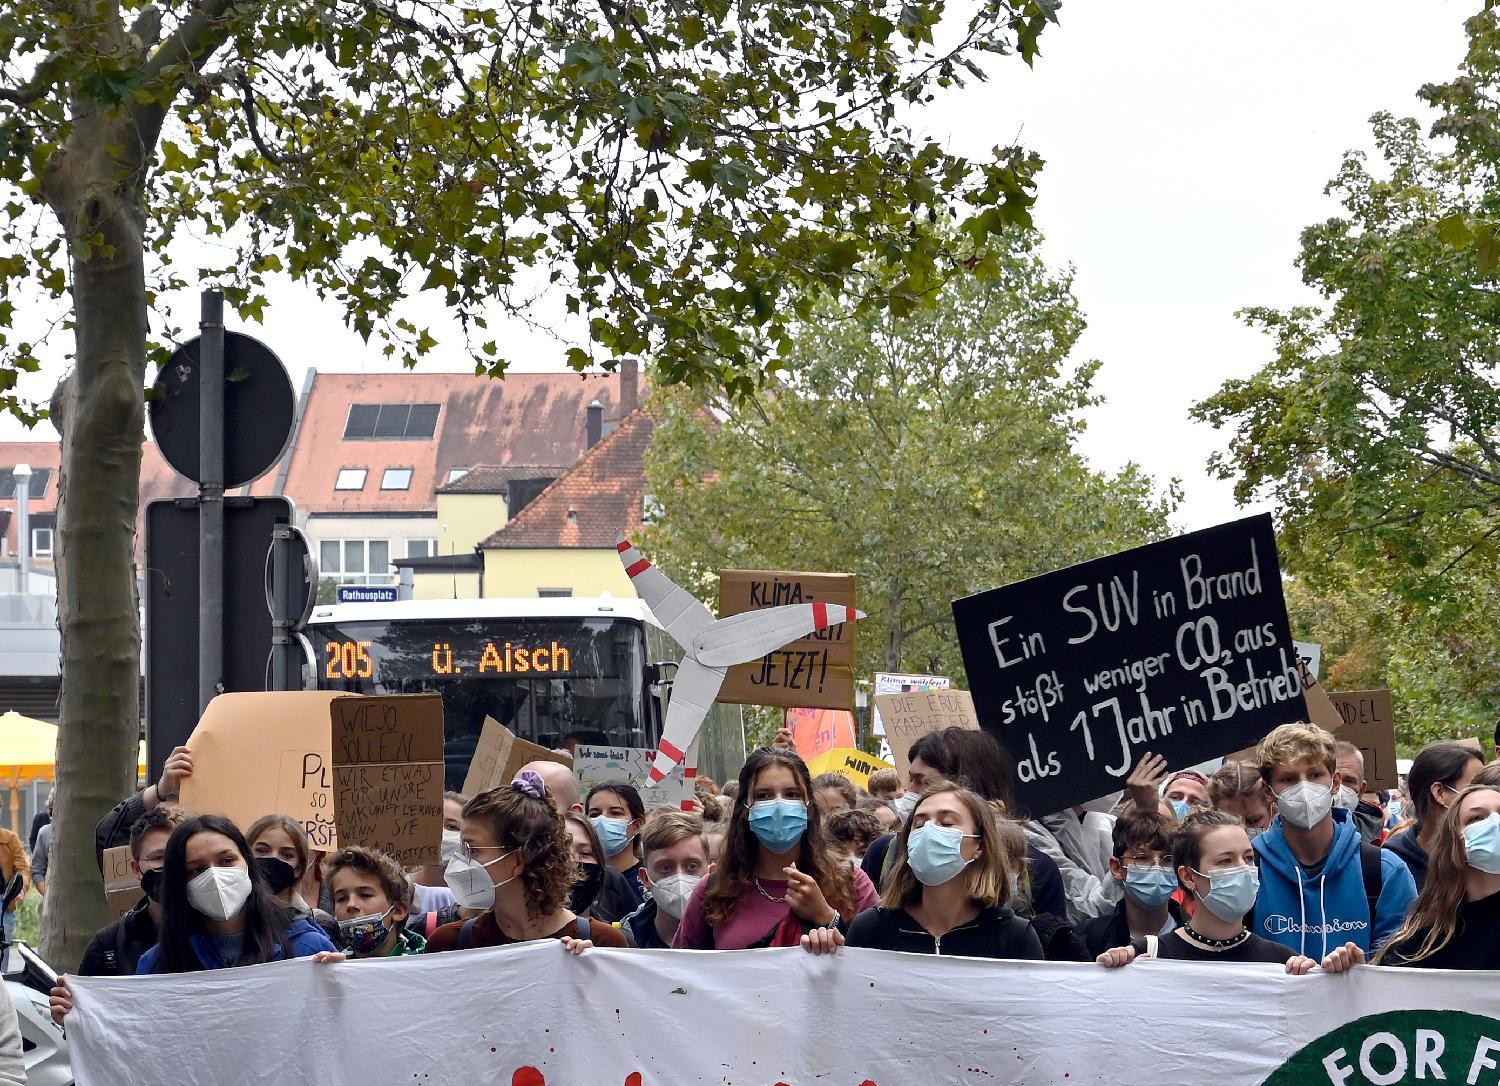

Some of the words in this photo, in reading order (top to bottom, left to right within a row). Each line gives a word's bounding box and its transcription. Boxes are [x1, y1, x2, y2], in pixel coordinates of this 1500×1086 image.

[342, 589, 394, 602] Rathausplatz
[988, 616, 1046, 669] Ein
[1063, 571, 1139, 645] SUV
[1153, 590, 1176, 619] in
[1180, 537, 1262, 611] Brand
[326, 641, 374, 679] 205
[432, 643, 462, 674] ü.
[479, 641, 571, 673] Aisch
[751, 648, 827, 694] JETZT!
[1002, 671, 1064, 723] stößt
[1083, 652, 1171, 693] weniger
[1234, 622, 1277, 655] aus
[910, 677, 947, 687] wählen!
[891, 696, 919, 713] DIE
[926, 693, 967, 714] ERDE
[1017, 732, 1062, 783] als
[1070, 711, 1095, 762] 1
[1092, 693, 1177, 778] Jahr
[1181, 699, 1207, 729] in
[1200, 647, 1302, 722] Betrieb
[340, 704, 398, 733] WIESO
[340, 731, 413, 764] SOLLEN
[337, 767, 373, 788] WIR
[382, 765, 432, 783] ETWAS
[340, 787, 370, 808] FÜR
[337, 804, 399, 826] ZUKUNFT
[342, 824, 376, 840] WENN
[392, 817, 419, 837] SIE
